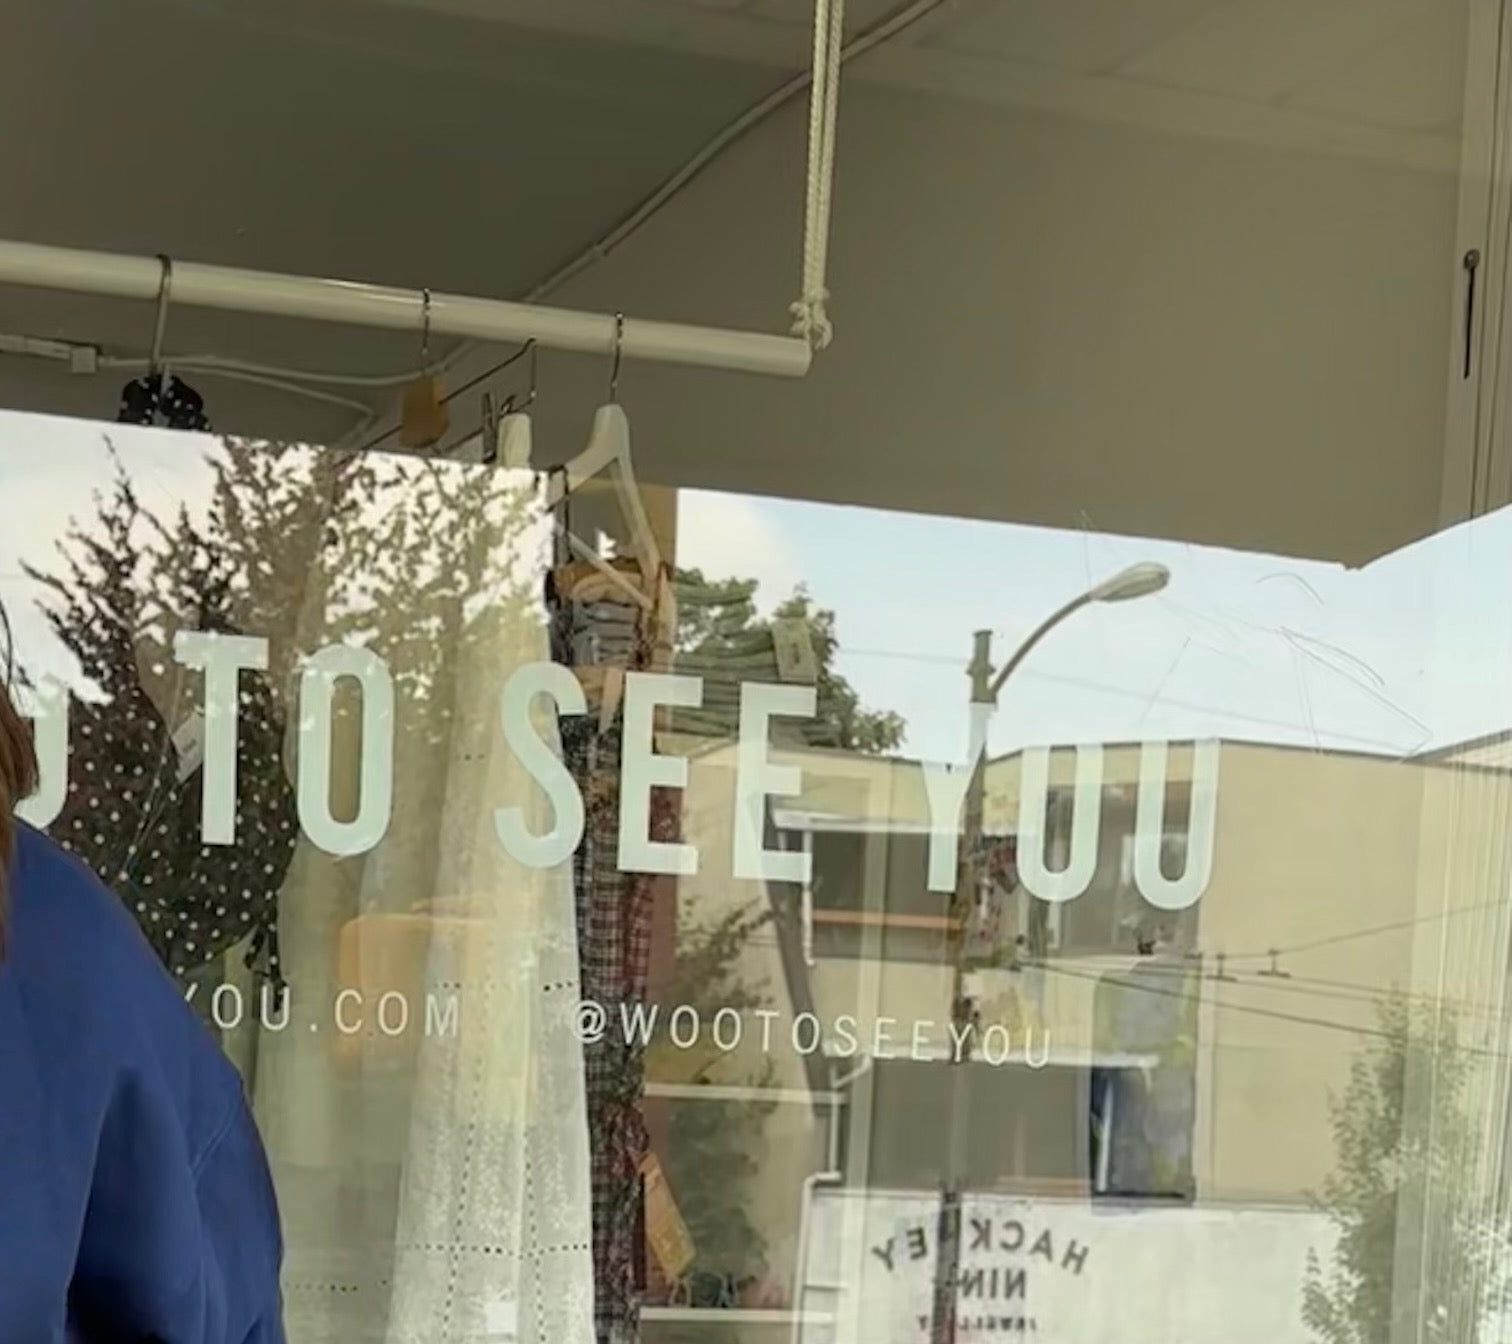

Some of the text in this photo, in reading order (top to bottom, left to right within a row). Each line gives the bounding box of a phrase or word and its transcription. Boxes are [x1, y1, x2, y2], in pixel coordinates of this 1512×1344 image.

[174, 629, 395, 858] TO
[494, 659, 818, 883] SEE
[911, 703, 1222, 911] YOU
[184, 982, 1051, 1069] OU.COM @WOOTOSEEYOU
